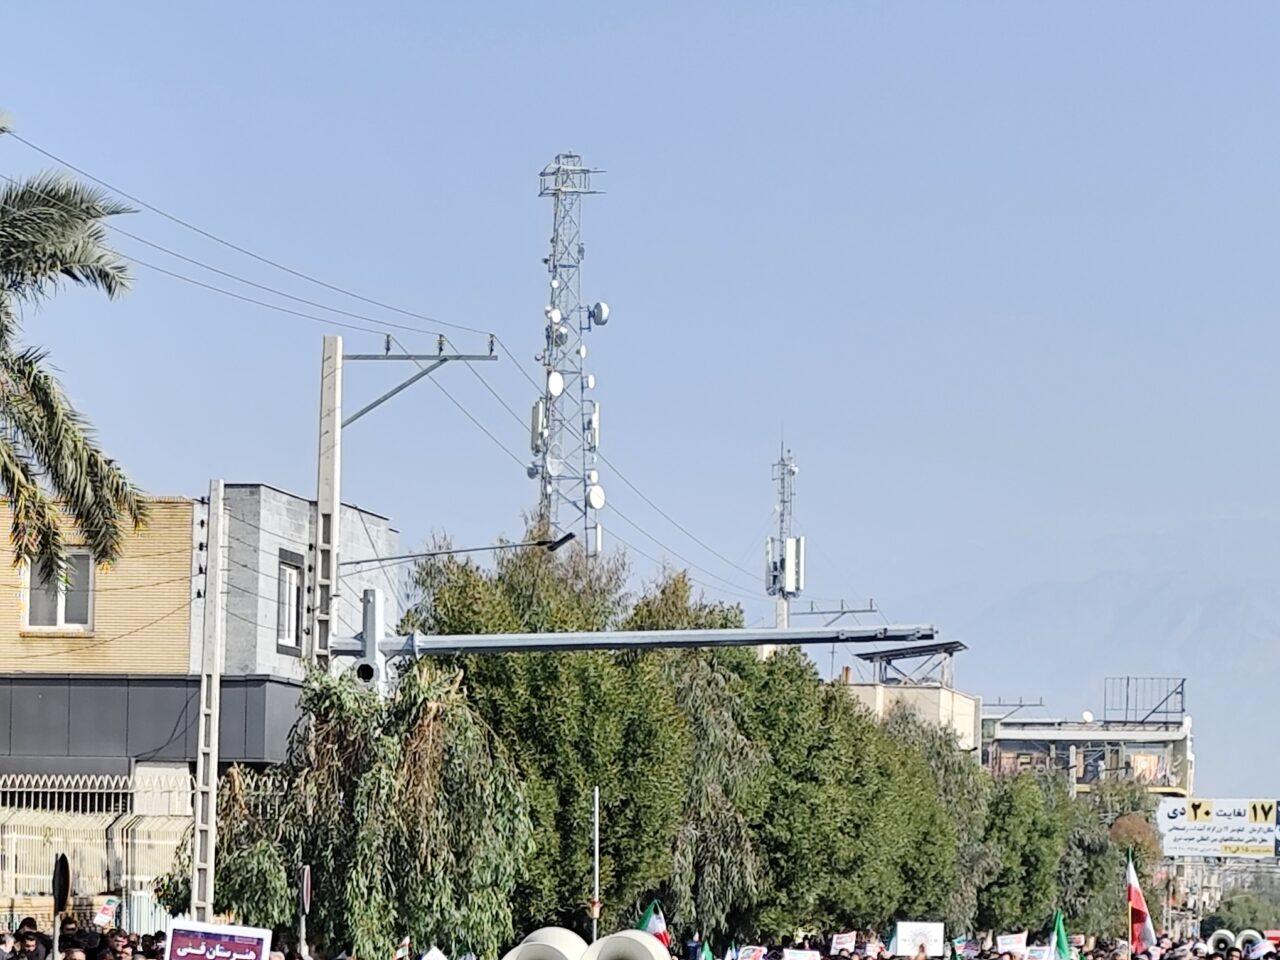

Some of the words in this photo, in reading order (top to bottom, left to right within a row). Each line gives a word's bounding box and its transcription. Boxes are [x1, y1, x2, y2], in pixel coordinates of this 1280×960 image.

[1167, 806, 1187, 820] دی
[1215, 808, 1247, 820] لغایت
[1251, 803, 1274, 822] ۱۷
